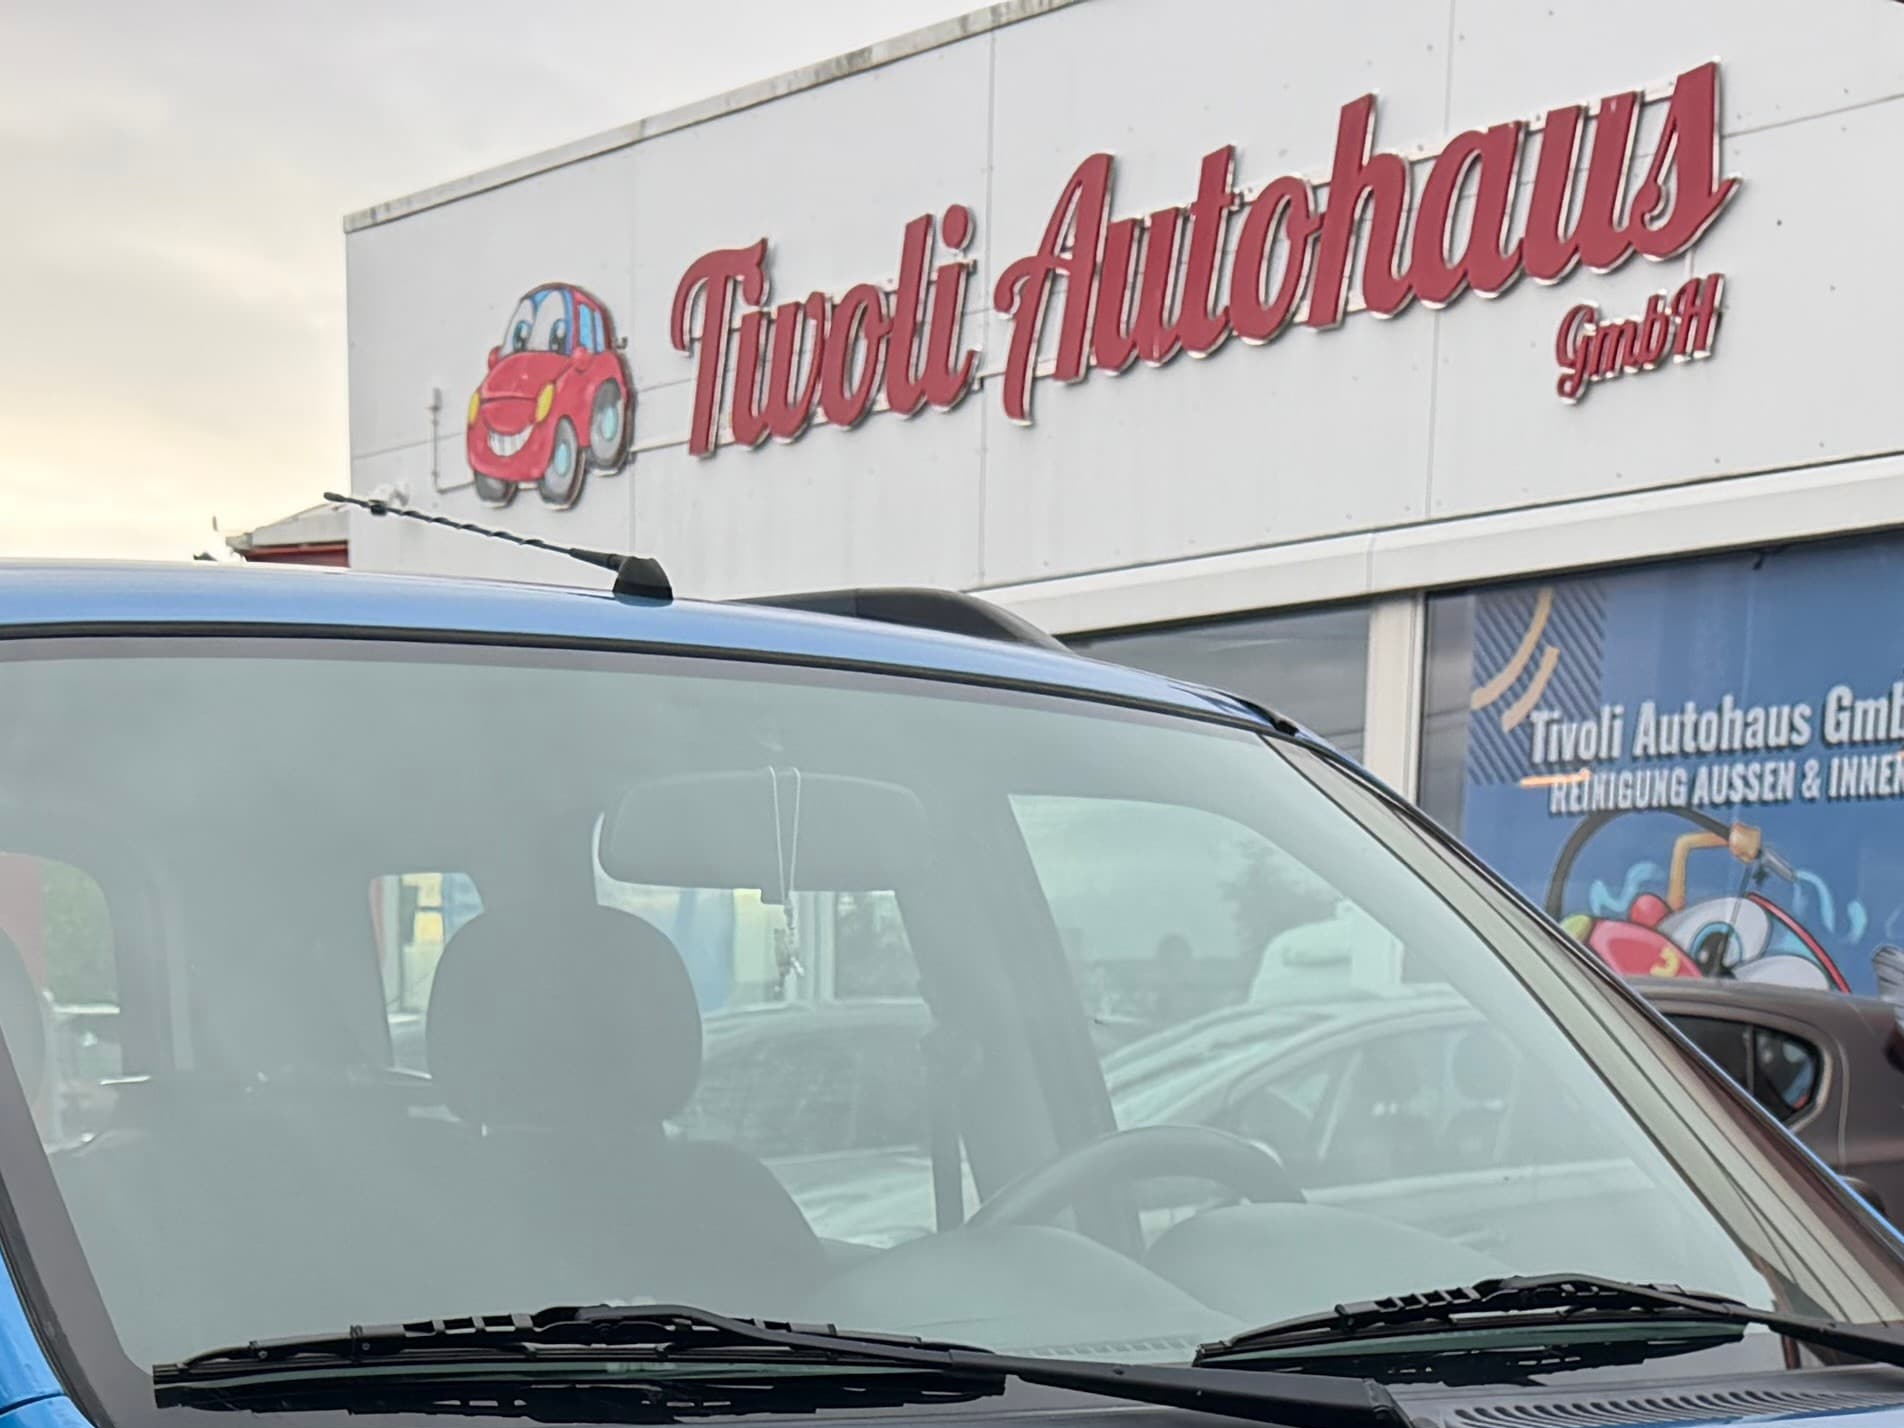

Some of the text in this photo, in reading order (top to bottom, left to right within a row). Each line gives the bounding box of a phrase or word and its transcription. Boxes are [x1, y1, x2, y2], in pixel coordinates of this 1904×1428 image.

[670, 60, 1741, 457] Tivoli Autohaus
[1555, 271, 1725, 404] GmbH
[1529, 702, 1625, 765] Tivoli
[1631, 693, 1813, 758] Autohaus
[1549, 765, 1689, 814] REINIGUNG
[1692, 759, 1796, 806] AUSSEN
[1801, 757, 1823, 800] &
